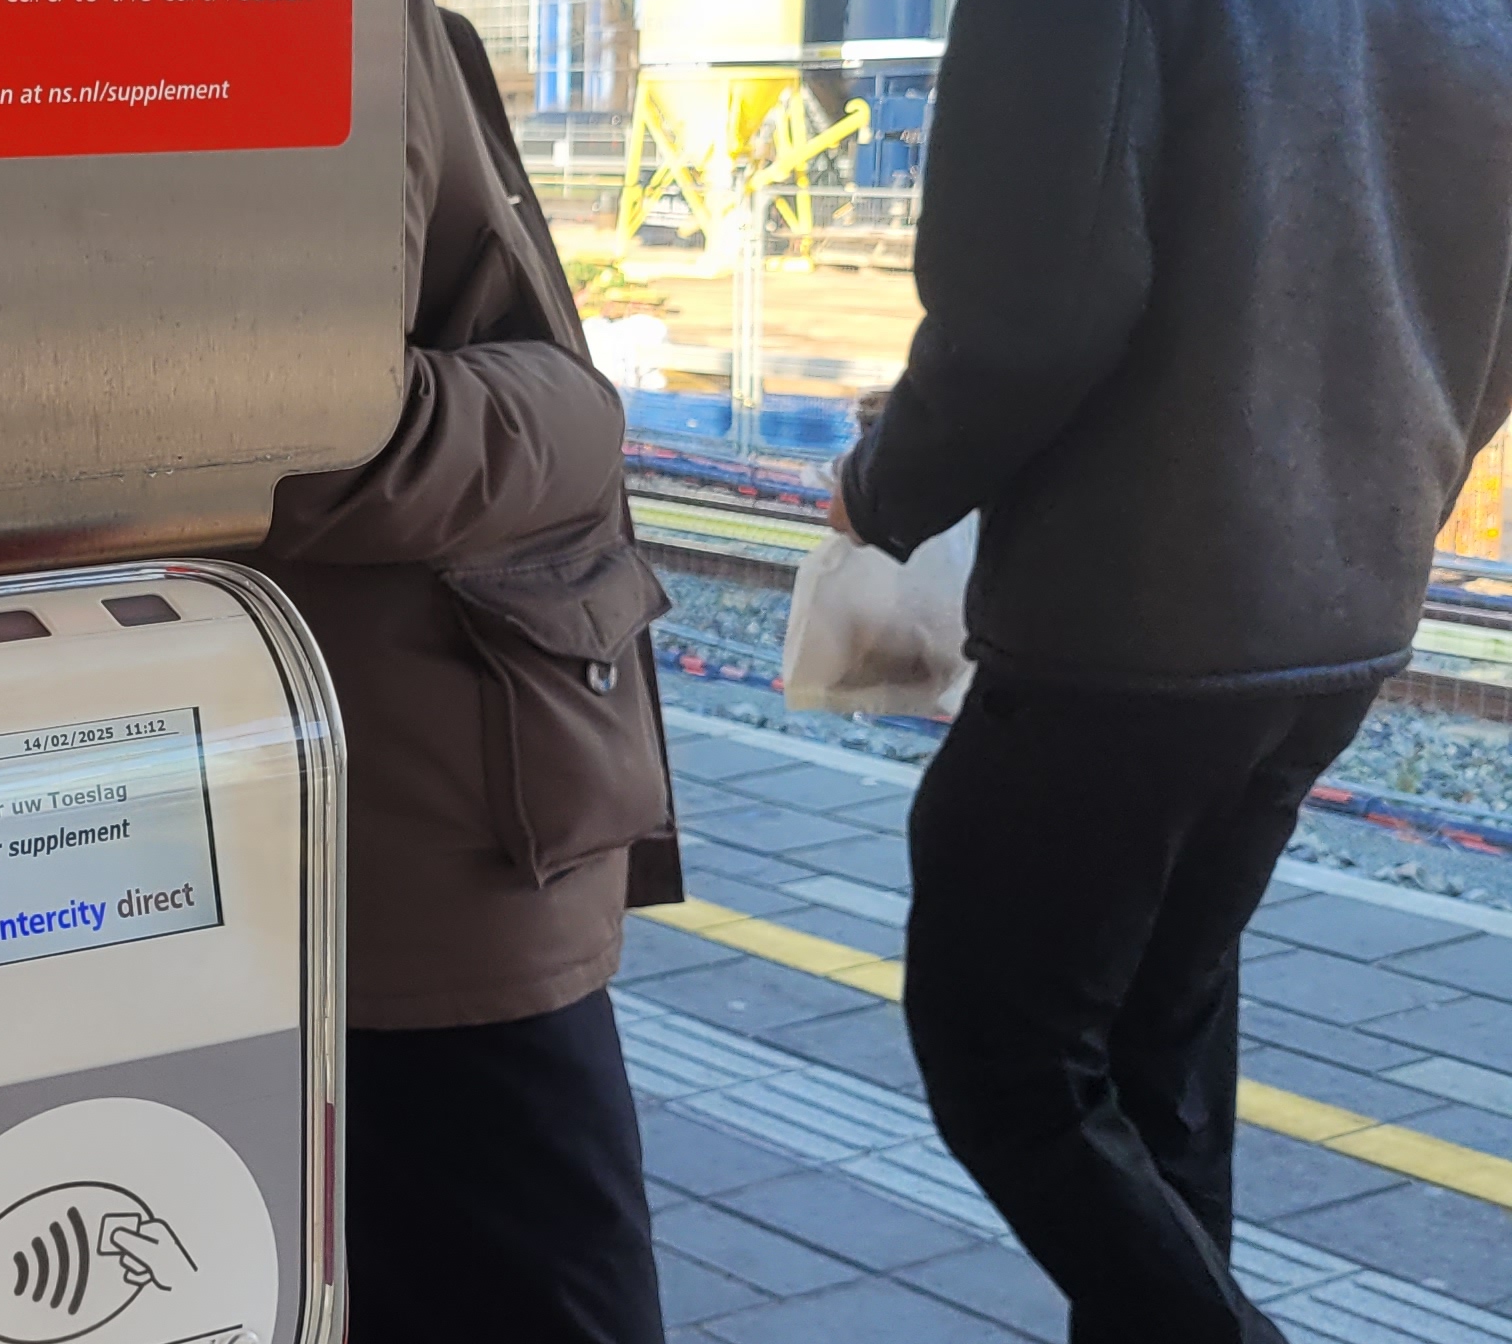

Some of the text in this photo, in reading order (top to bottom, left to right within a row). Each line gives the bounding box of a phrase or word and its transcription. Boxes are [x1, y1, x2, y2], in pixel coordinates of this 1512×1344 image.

[20, 84, 43, 104] at
[48, 79, 230, 107] ns.nl/supplement
[23, 718, 166, 752] 14/02/2025 11:12
[11, 798, 42, 815] uw
[47, 782, 129, 810] Toeslag
[7, 818, 131, 859] supplement
[116, 882, 195, 919] direct
